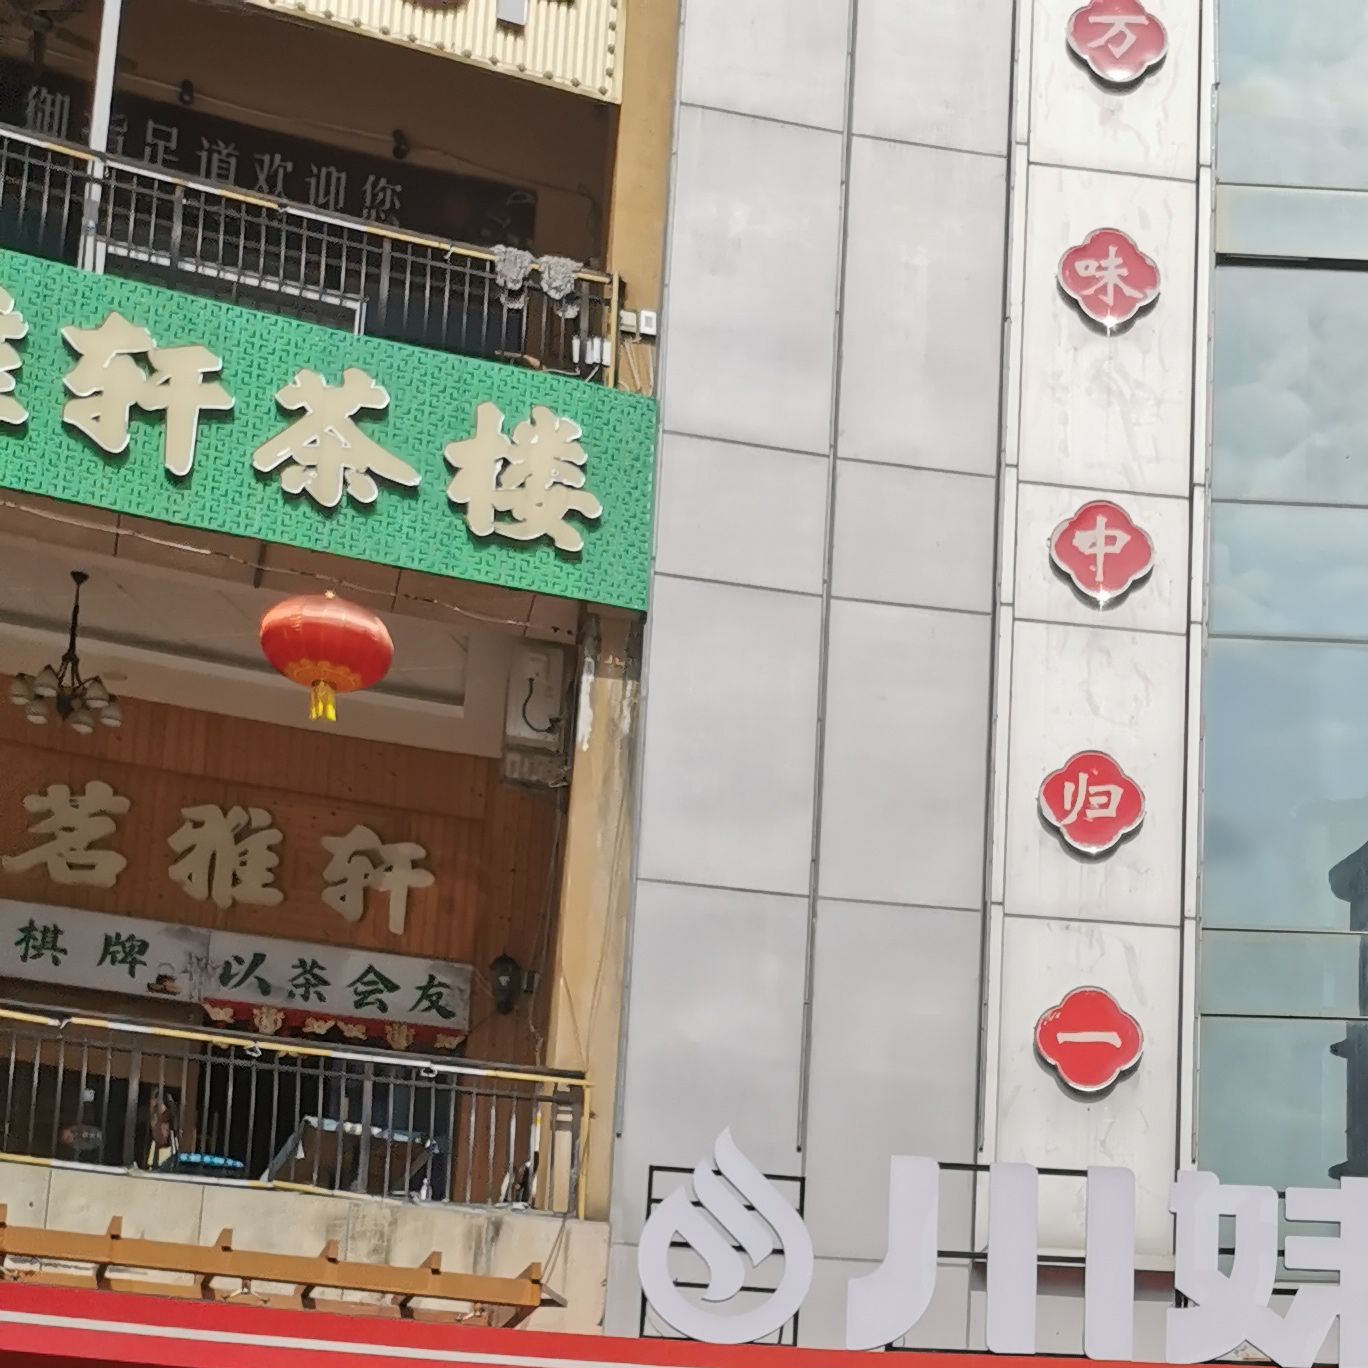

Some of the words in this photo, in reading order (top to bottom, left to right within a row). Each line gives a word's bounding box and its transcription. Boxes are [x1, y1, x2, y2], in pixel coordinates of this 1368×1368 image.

[2, 780, 435, 935] 茗雅轩
[14, 918, 150, 979] 棋牌
[218, 951, 458, 1020] 以茶会友
